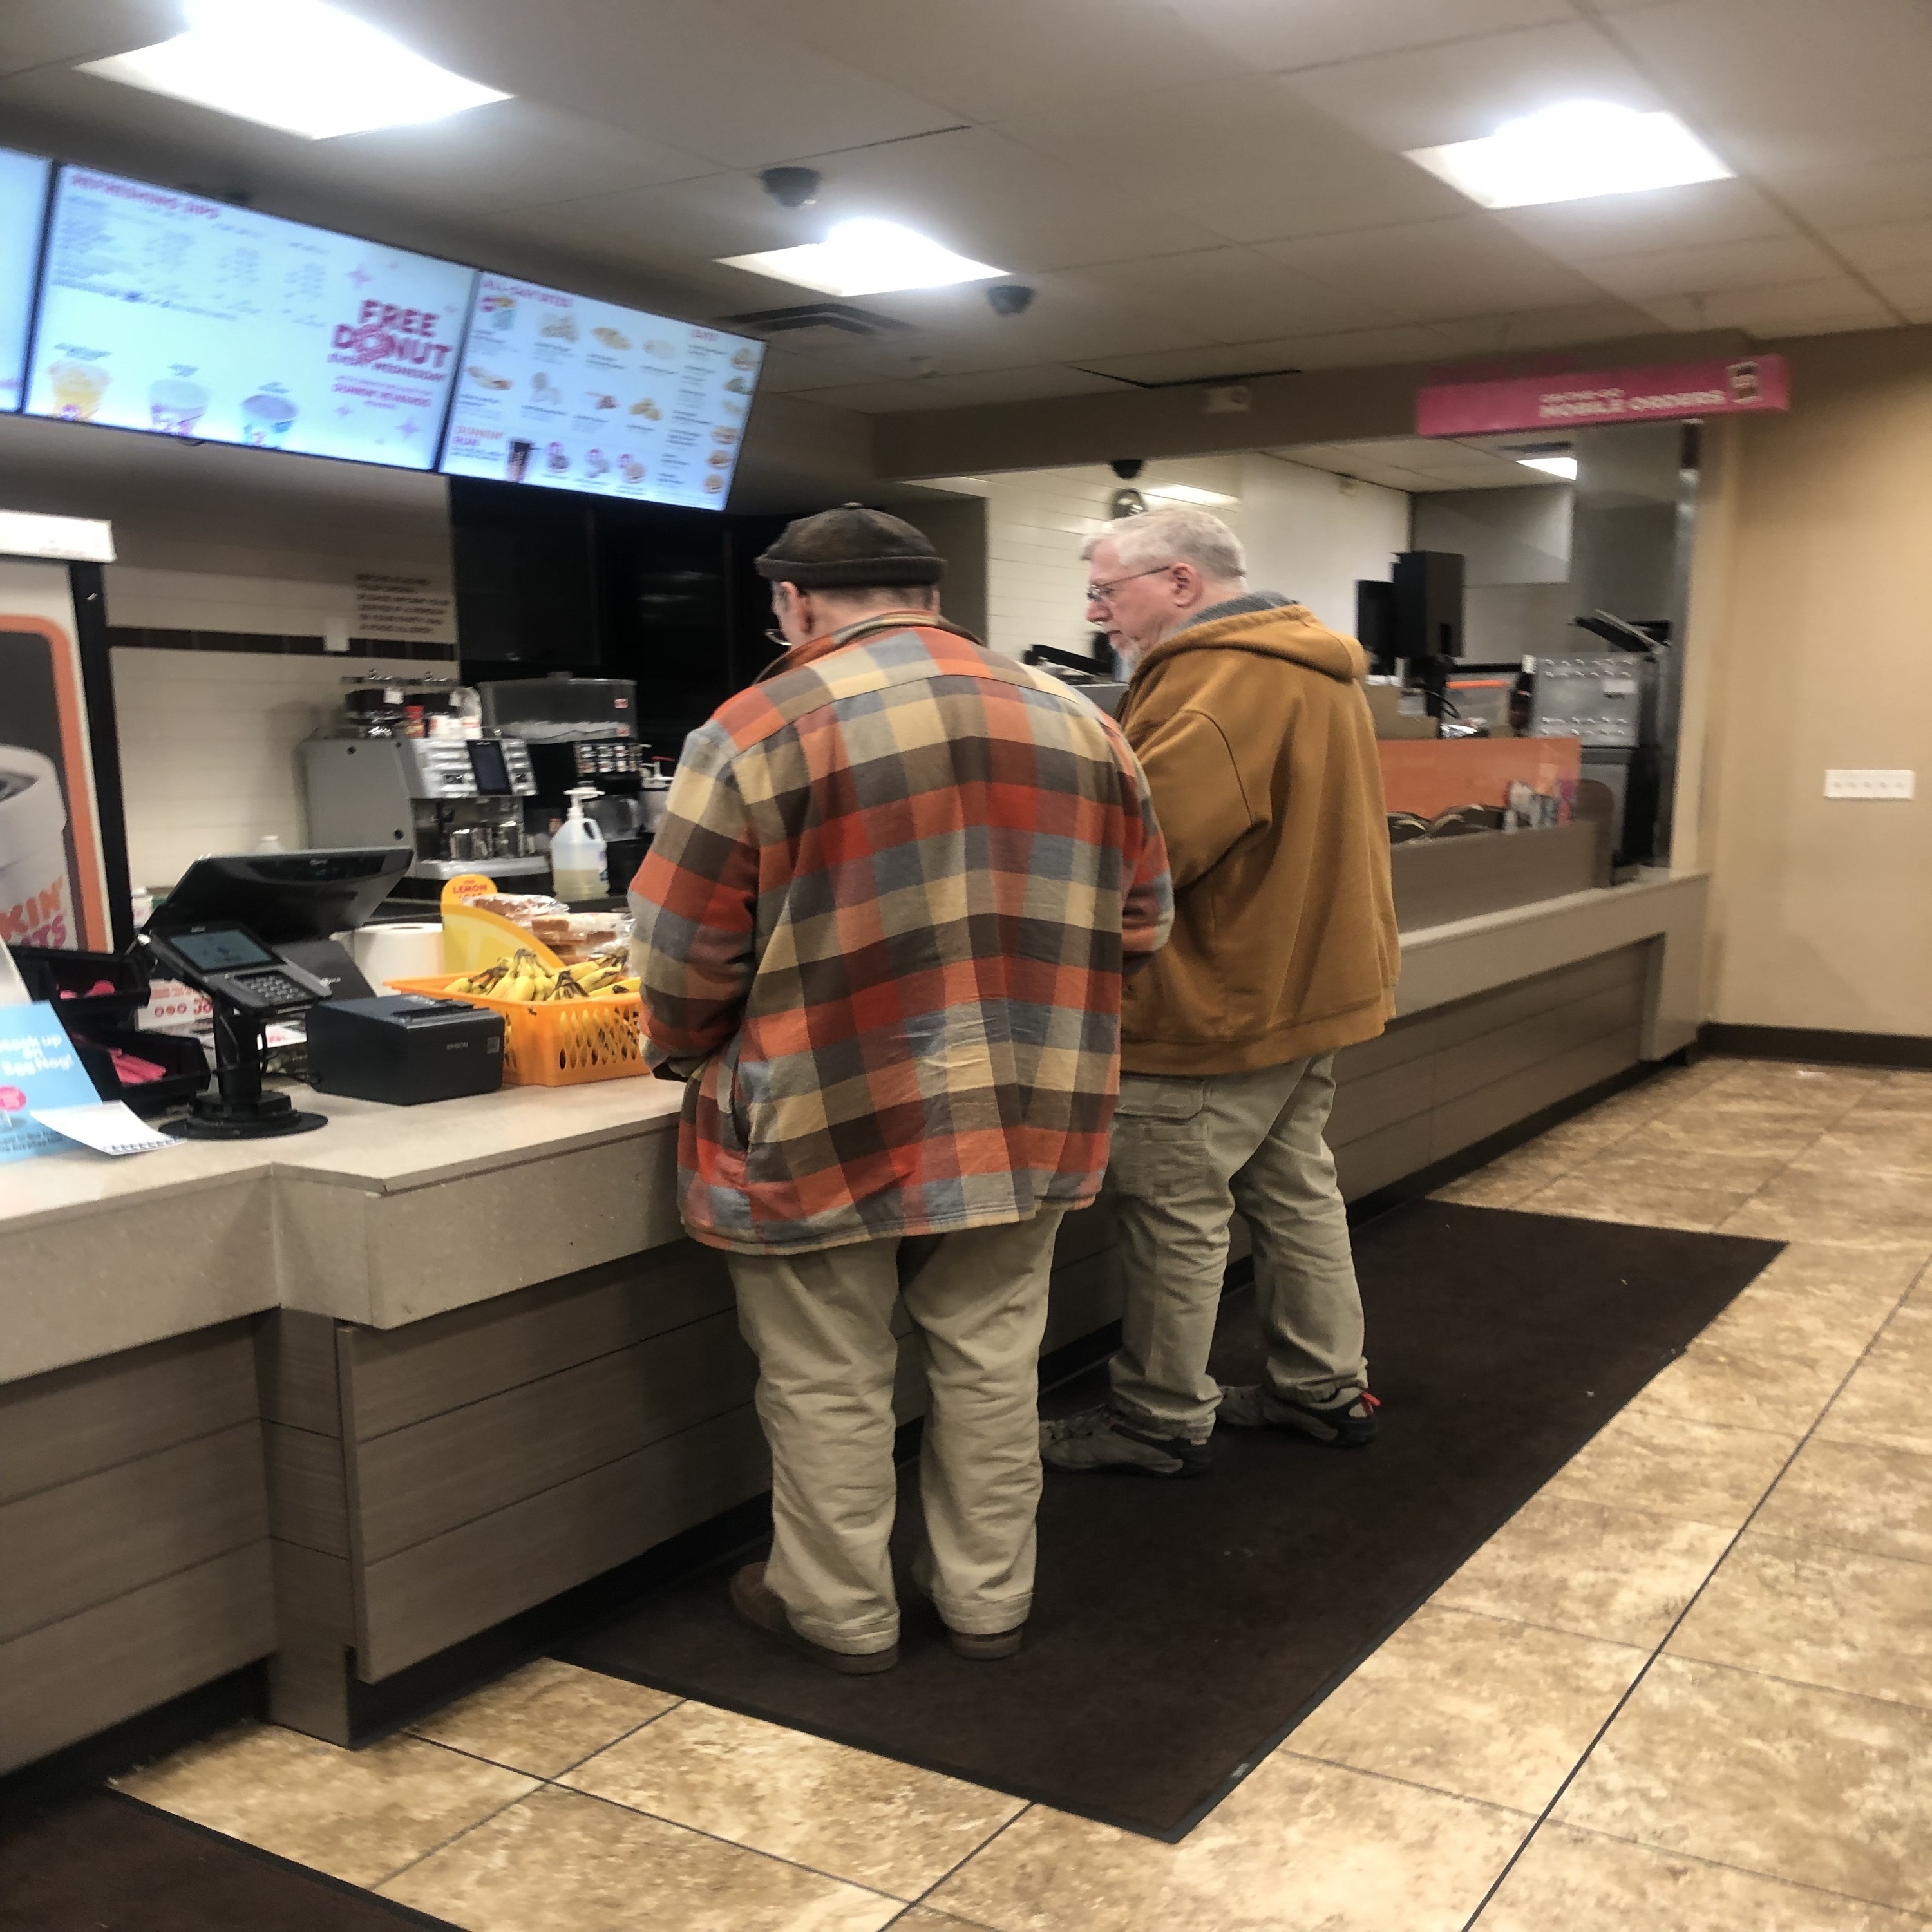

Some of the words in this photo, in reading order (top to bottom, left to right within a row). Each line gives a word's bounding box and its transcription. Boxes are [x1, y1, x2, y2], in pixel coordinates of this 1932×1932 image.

[357, 299, 439, 337] FREE
[330, 323, 452, 369] DONUT
[453, 884, 488, 894] LEMON
[446, 1041, 469, 1050] EPSON
